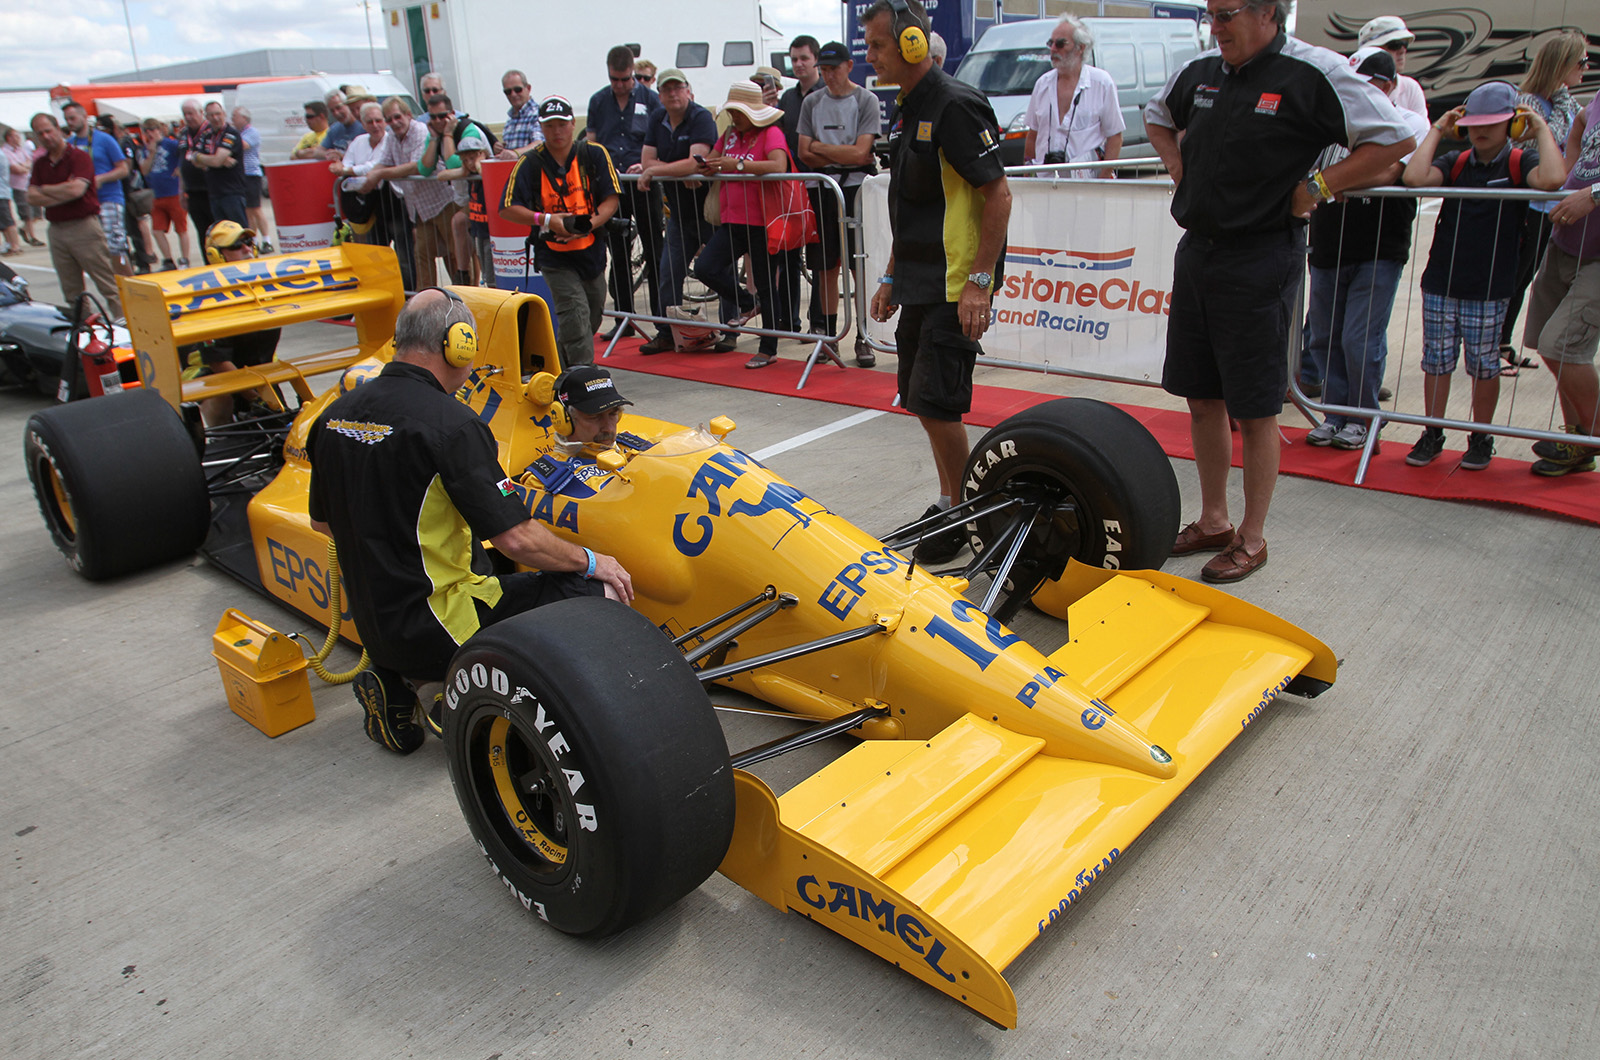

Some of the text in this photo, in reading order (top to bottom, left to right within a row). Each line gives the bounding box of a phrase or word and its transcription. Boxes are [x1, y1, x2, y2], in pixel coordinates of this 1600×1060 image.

[534, 444, 556, 456] Nak
[924, 599, 1024, 672] 12
[1015, 664, 1069, 709] PIA
[1080, 697, 1117, 730] el
[446, 663, 598, 832] GOODYEAR
[539, 839, 567, 861] Racing
[796, 875, 956, 983] CAMEL
